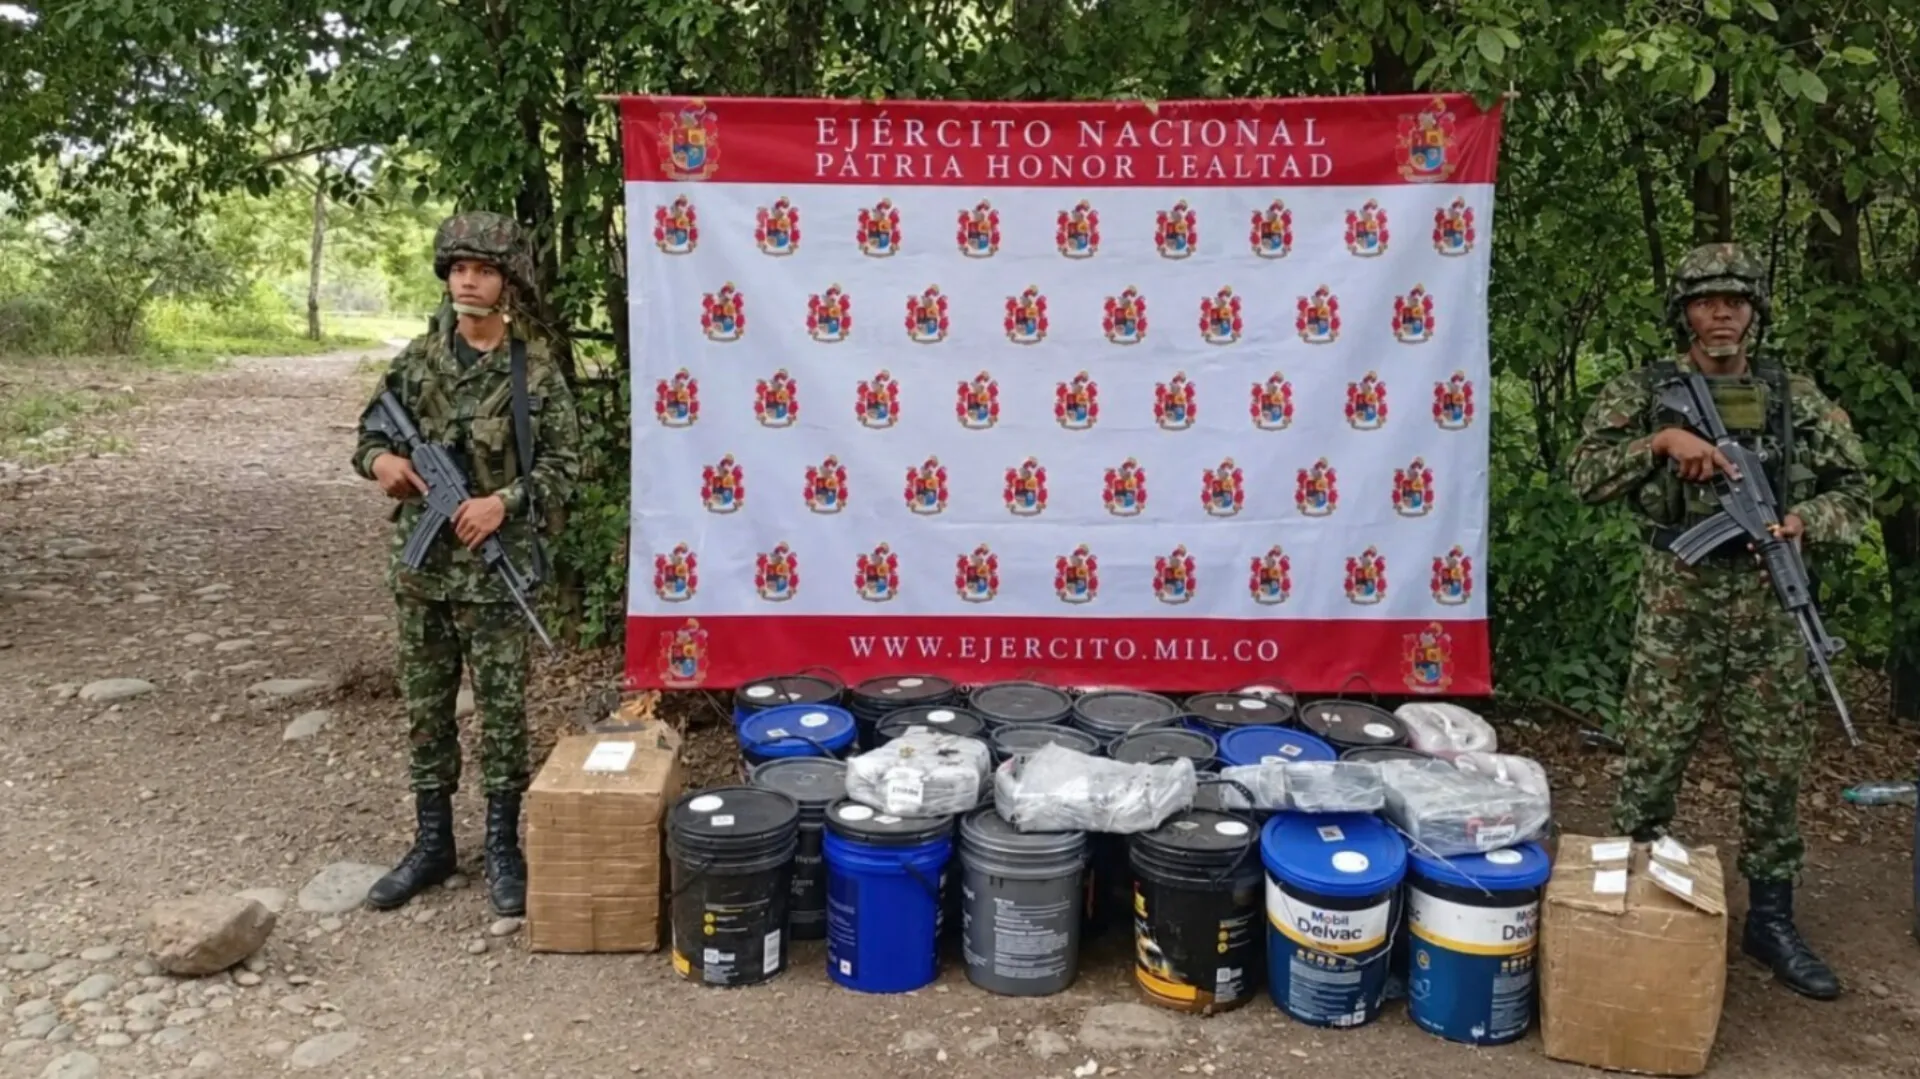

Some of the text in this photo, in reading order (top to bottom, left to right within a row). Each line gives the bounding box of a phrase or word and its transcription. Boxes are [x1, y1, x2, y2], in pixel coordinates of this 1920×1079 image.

[815, 110, 1327, 151] EJÉRCITO NACIONAL
[986, 153, 1134, 179] HONOR
[1157, 153, 1333, 179] LEALTAD
[849, 635, 1279, 663] WWW.EJERCITO.MIL.CO
[1297, 916, 1362, 940] Delvac
[1311, 910, 1349, 925] Mobil
